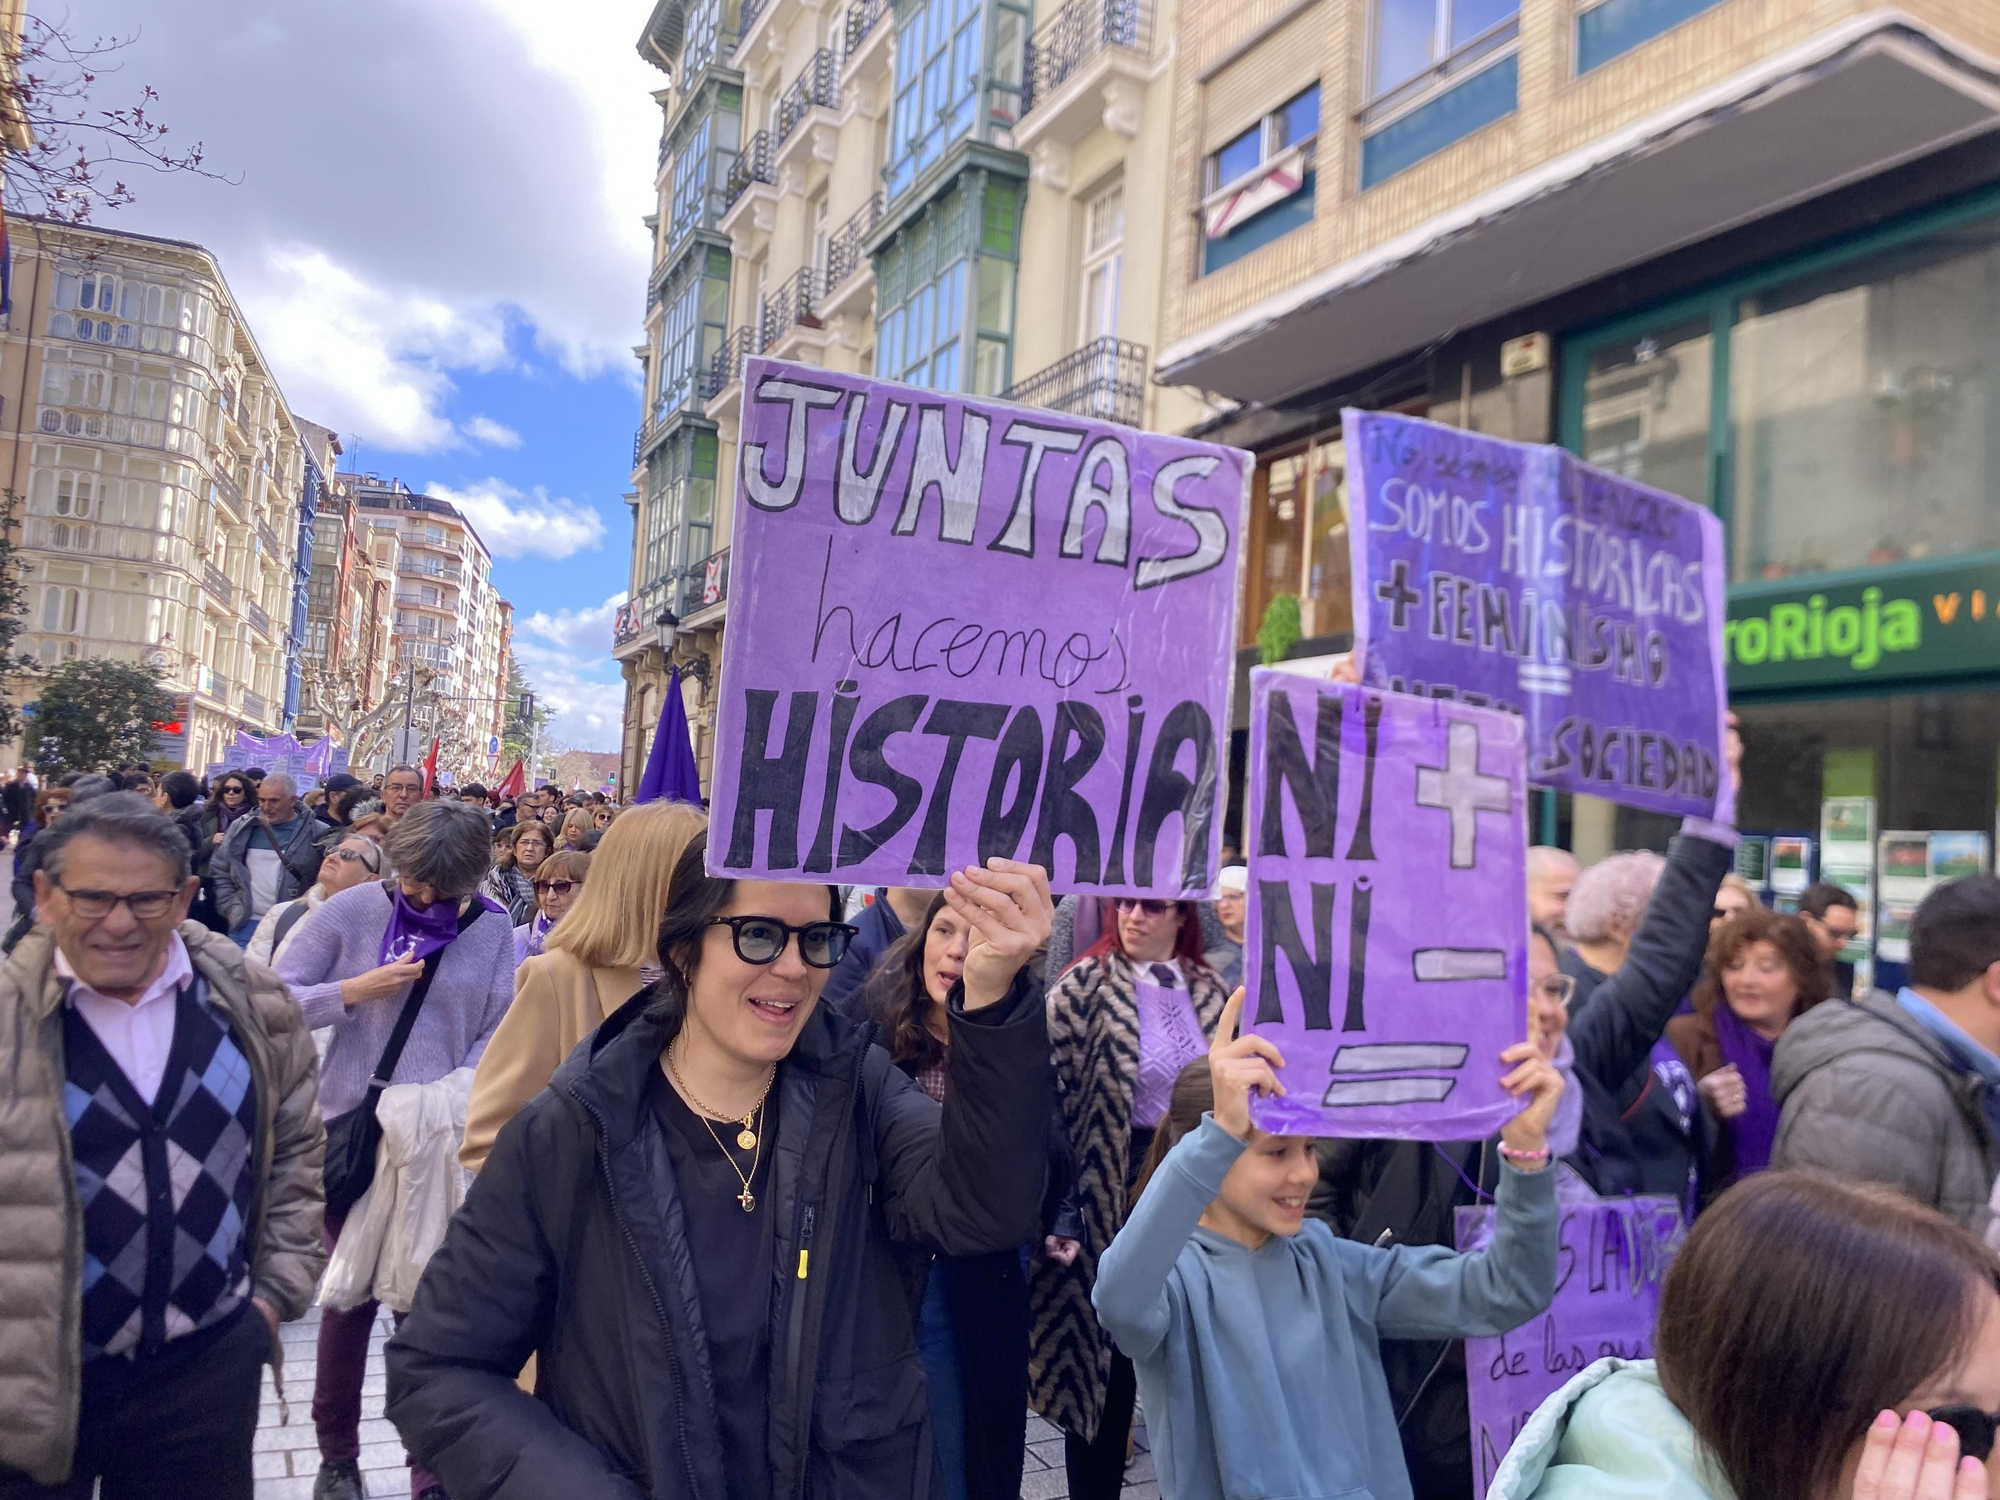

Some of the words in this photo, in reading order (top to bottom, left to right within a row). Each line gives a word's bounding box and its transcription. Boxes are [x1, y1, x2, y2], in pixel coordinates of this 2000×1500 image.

[740, 374, 1229, 591] JUNTAS
[1368, 478, 1490, 553] SOMOS
[811, 534, 1132, 694] hacemos
[1428, 570, 1667, 689] FEMINISMO
[1537, 714, 1719, 800] SOCIEDAD
[1490, 1331, 1528, 1381] de
